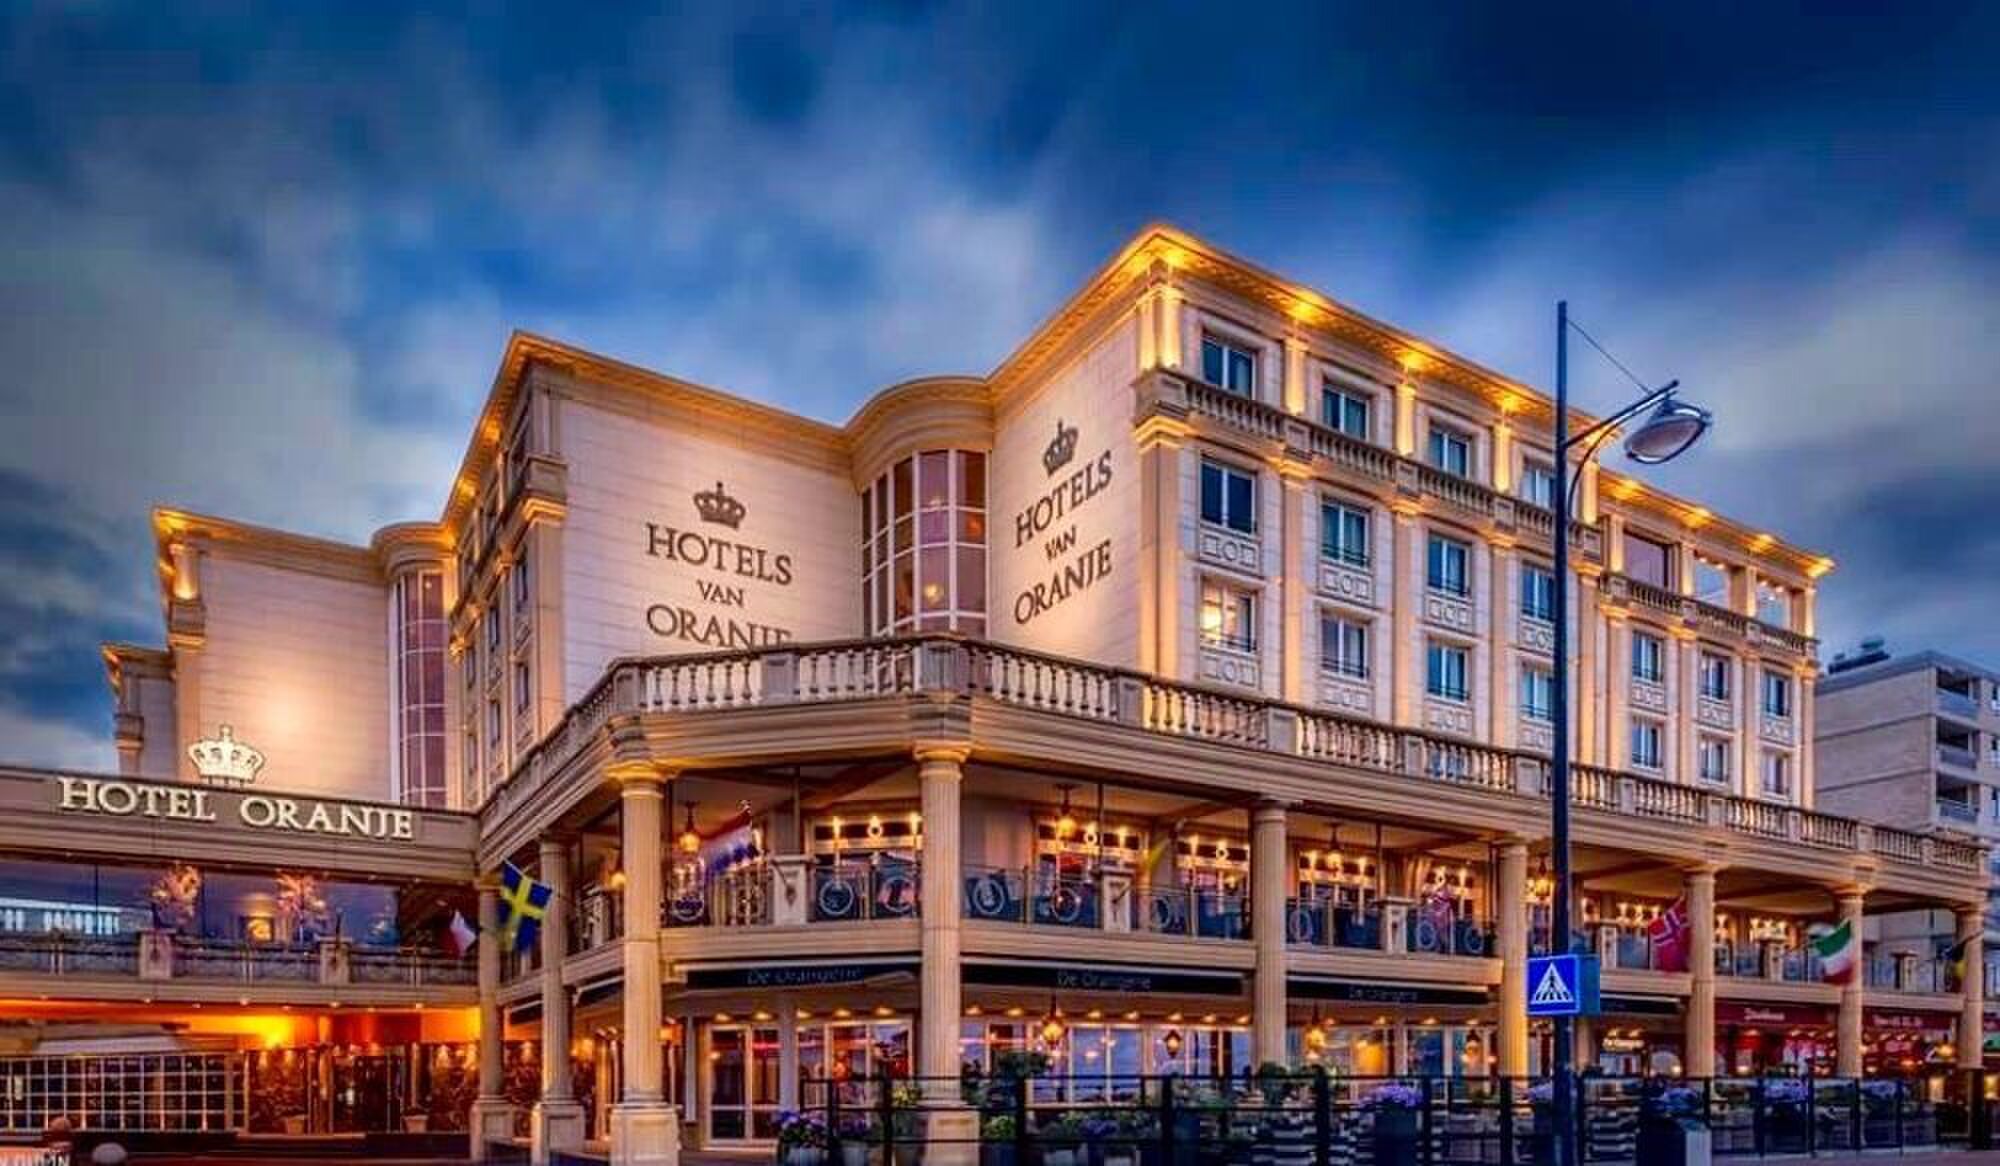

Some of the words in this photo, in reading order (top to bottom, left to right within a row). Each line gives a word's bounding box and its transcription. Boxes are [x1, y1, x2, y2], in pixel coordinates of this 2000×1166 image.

[1014, 449, 1113, 548] HOTELS
[646, 522, 793, 586] HOTELS
[1045, 524, 1077, 561] VAN
[696, 579, 745, 607] VAN
[1014, 538, 1113, 625] ORANJE
[57, 776, 216, 822] HOTEL
[239, 796, 414, 840] ORANJE
